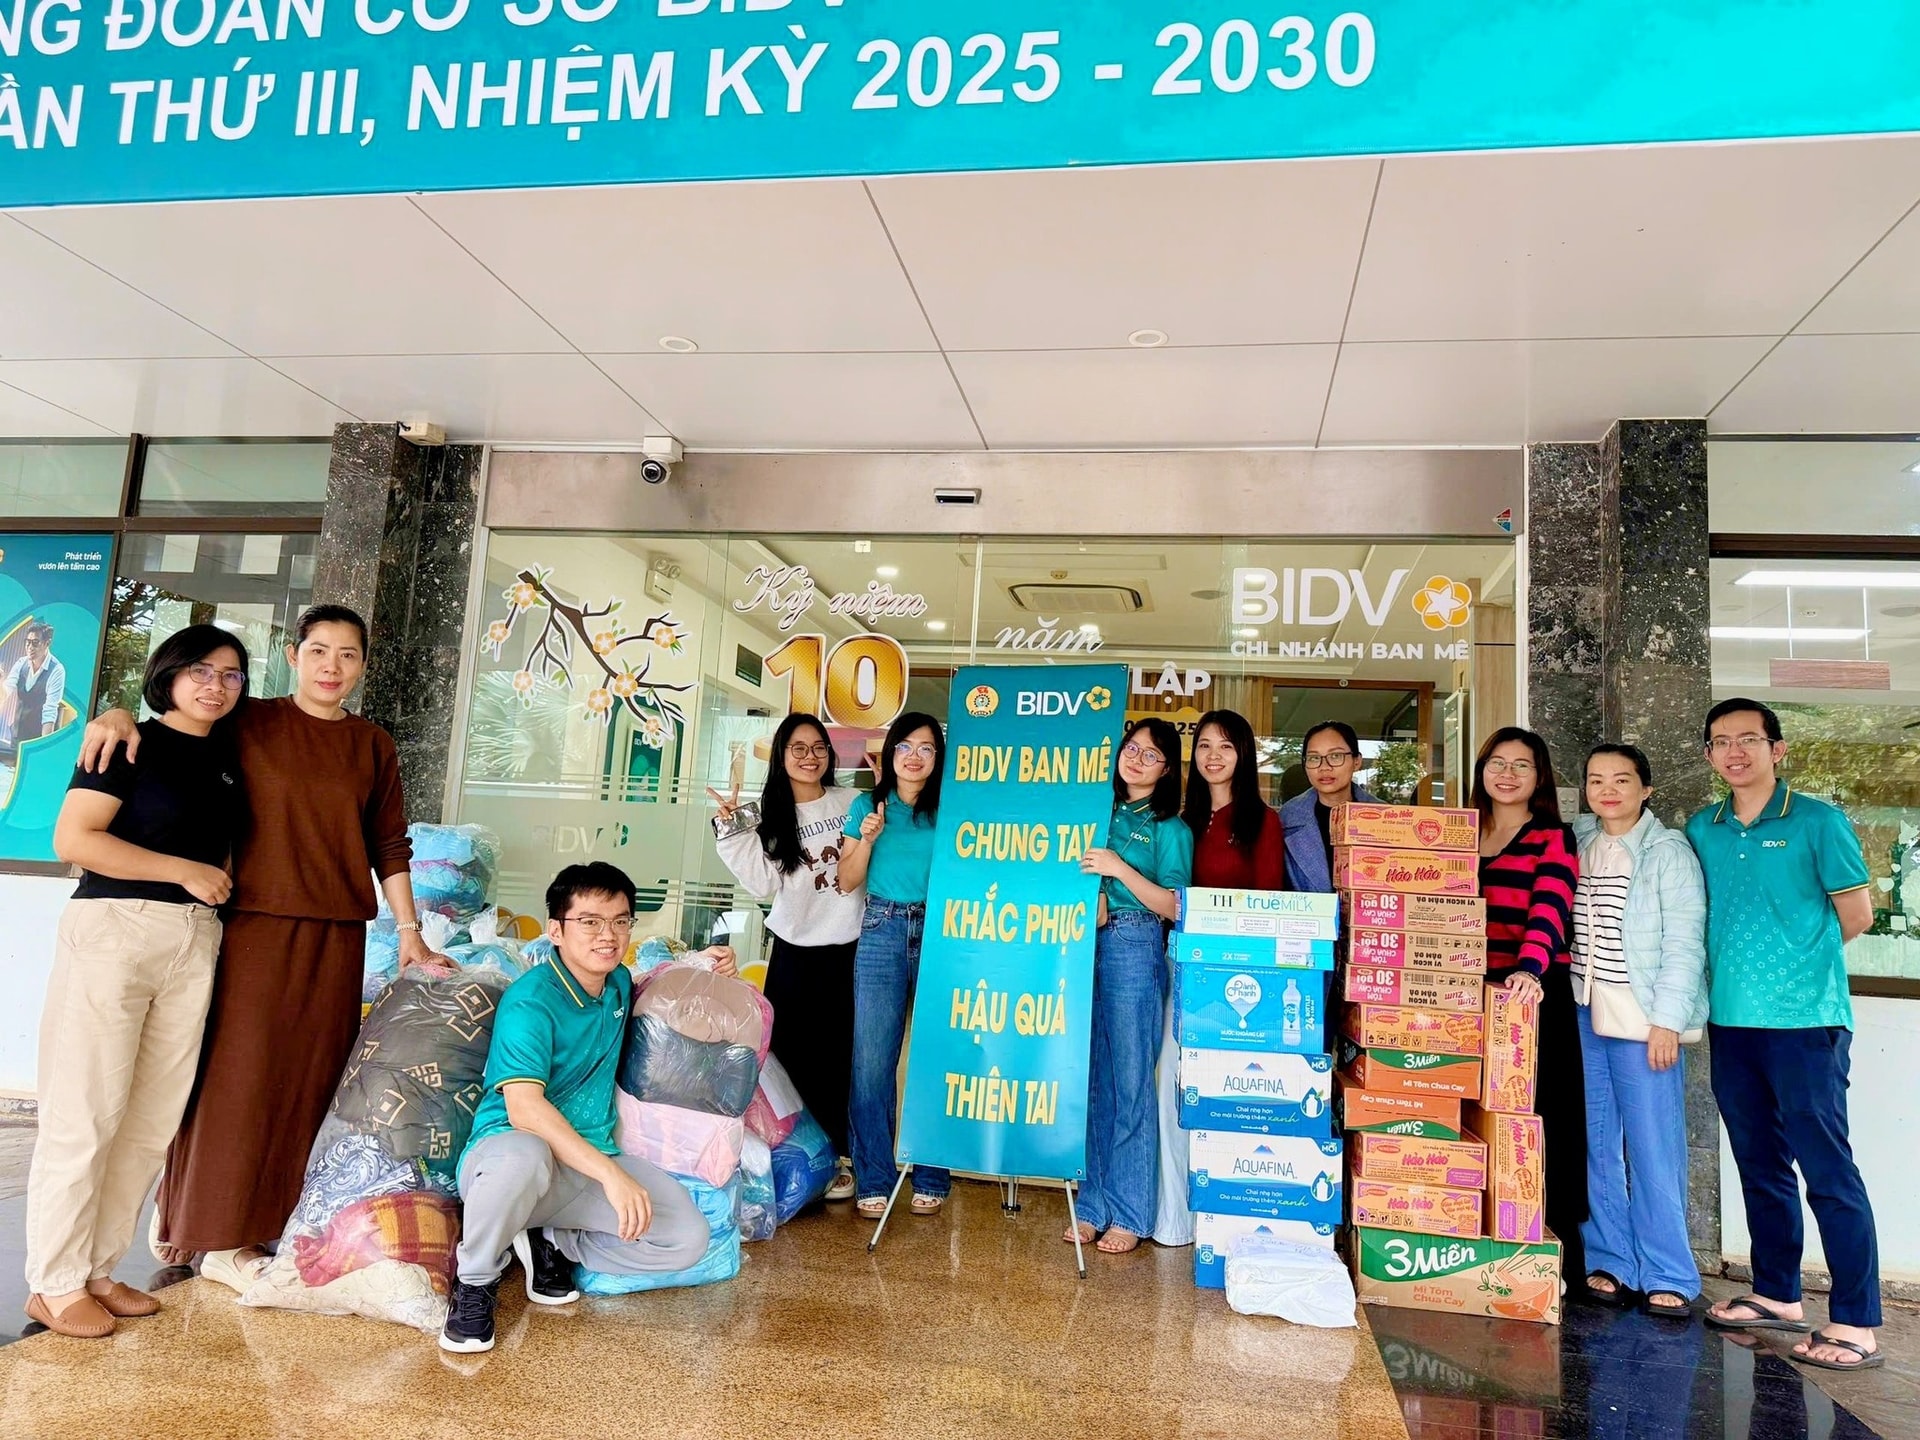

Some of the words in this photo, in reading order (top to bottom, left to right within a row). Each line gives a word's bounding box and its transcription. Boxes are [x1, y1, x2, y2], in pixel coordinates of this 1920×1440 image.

[109, 57, 276, 145] THỨ
[295, 68, 375, 147] III,
[405, 43, 673, 141] NHIỆM
[704, 24, 831, 117] KỲ
[850, 30, 1062, 111] 2025
[1093, 62, 1124, 81] -
[1151, 11, 1377, 97] 2030
[65, 552, 82, 561] Phát
[733, 564, 815, 631] Kỷ
[829, 580, 928, 625] niệm
[1231, 567, 1409, 626] BIDV
[993, 616, 1104, 655] năm
[1230, 640, 1268, 657] CHI
[1279, 637, 1364, 659] NHÁNH
[1371, 643, 1423, 660] BAN
[1434, 638, 1470, 660] MÊ
[763, 632, 909, 728] 10
[1131, 660, 1212, 704] LẬP
[1016, 690, 1087, 716] BIDV
[955, 744, 1013, 783] BIDV
[1018, 745, 1069, 784] BAN
[1077, 735, 1112, 784] MÊ
[956, 821, 1050, 863] CHUNG
[1056, 822, 1097, 863] TAY
[1209, 893, 1233, 908] TH
[1380, 894, 1398, 909] 30
[942, 882, 1019, 943] KHẮC
[1024, 900, 1087, 956] PHỤC
[1380, 932, 1399, 948] 30
[1376, 970, 1395, 986] 30
[950, 978, 1008, 1044] HẬU
[1014, 977, 1067, 1037] QUẢ
[945, 1065, 1019, 1124] THIÊN
[1024, 1080, 1059, 1125] TAI
[1223, 1075, 1286, 1096] AQUAFINA
[1197, 1131, 1207, 1139] 24
[1232, 1157, 1296, 1179] AQUAFINA
[1413, 1293, 1442, 1304] Chua
[1444, 1297, 1465, 1307] Cay
